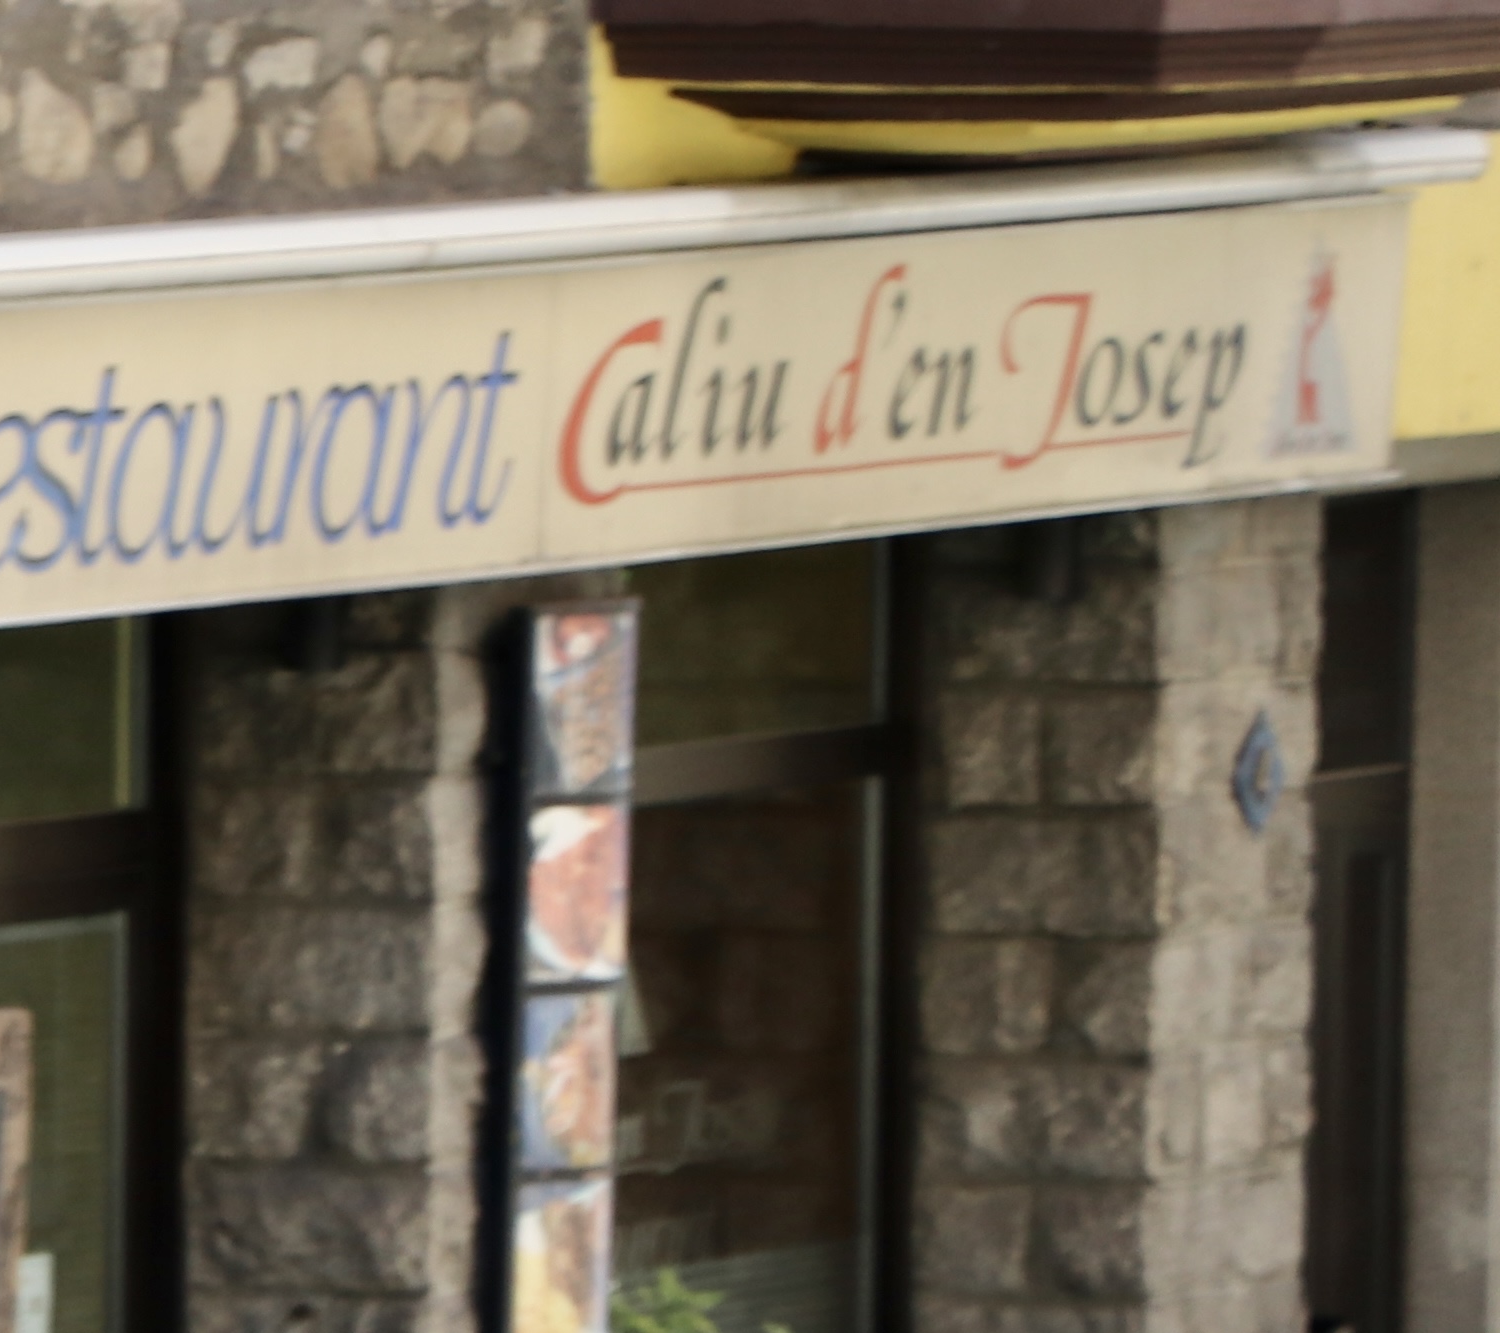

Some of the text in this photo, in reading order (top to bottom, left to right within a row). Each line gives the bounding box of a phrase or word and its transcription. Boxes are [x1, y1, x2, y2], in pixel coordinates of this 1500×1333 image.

[557, 276, 790, 505] Caliu
[812, 263, 979, 456] d'en
[999, 292, 1248, 470] Josep
